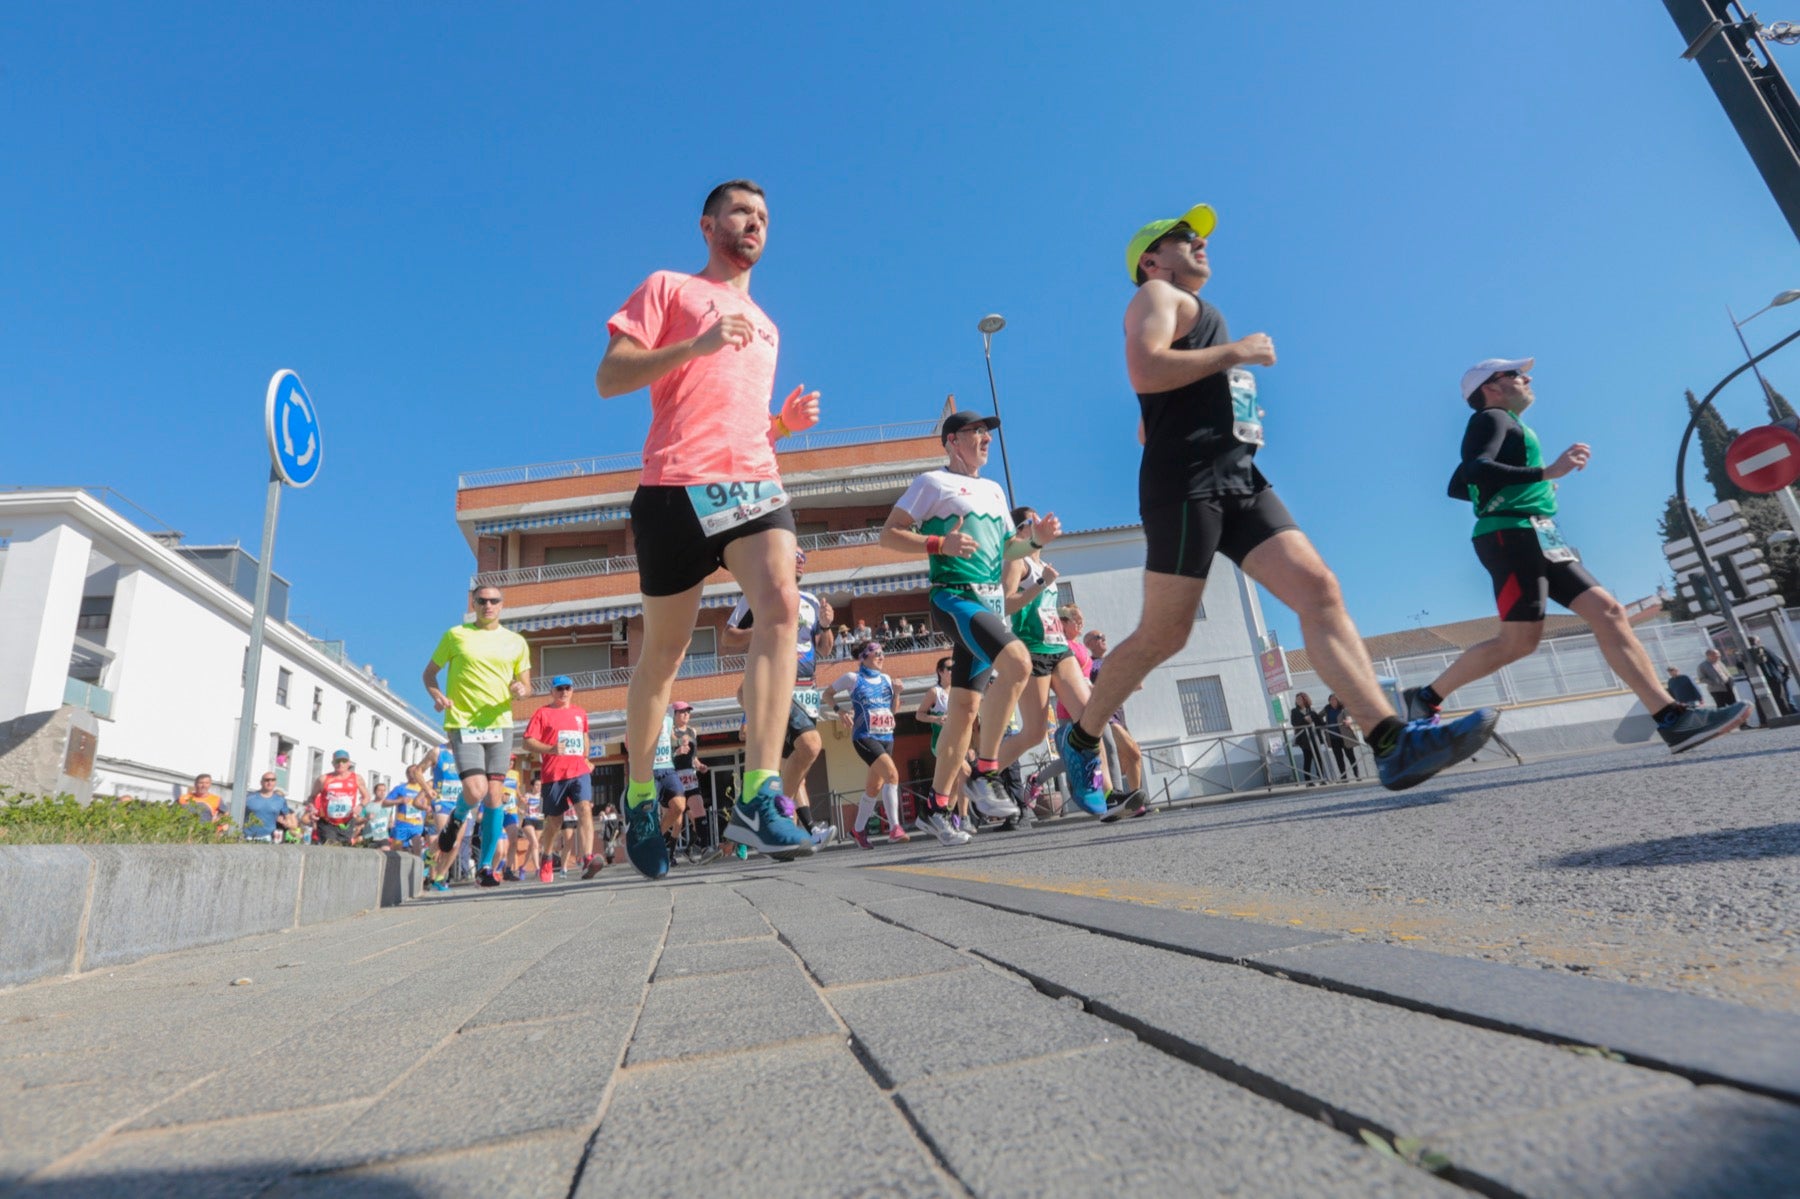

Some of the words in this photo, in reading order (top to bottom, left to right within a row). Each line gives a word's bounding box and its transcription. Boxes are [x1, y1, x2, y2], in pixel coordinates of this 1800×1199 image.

[706, 482, 760, 507] 947
[701, 718, 743, 731] PARAD
[565, 737, 582, 748] 293
